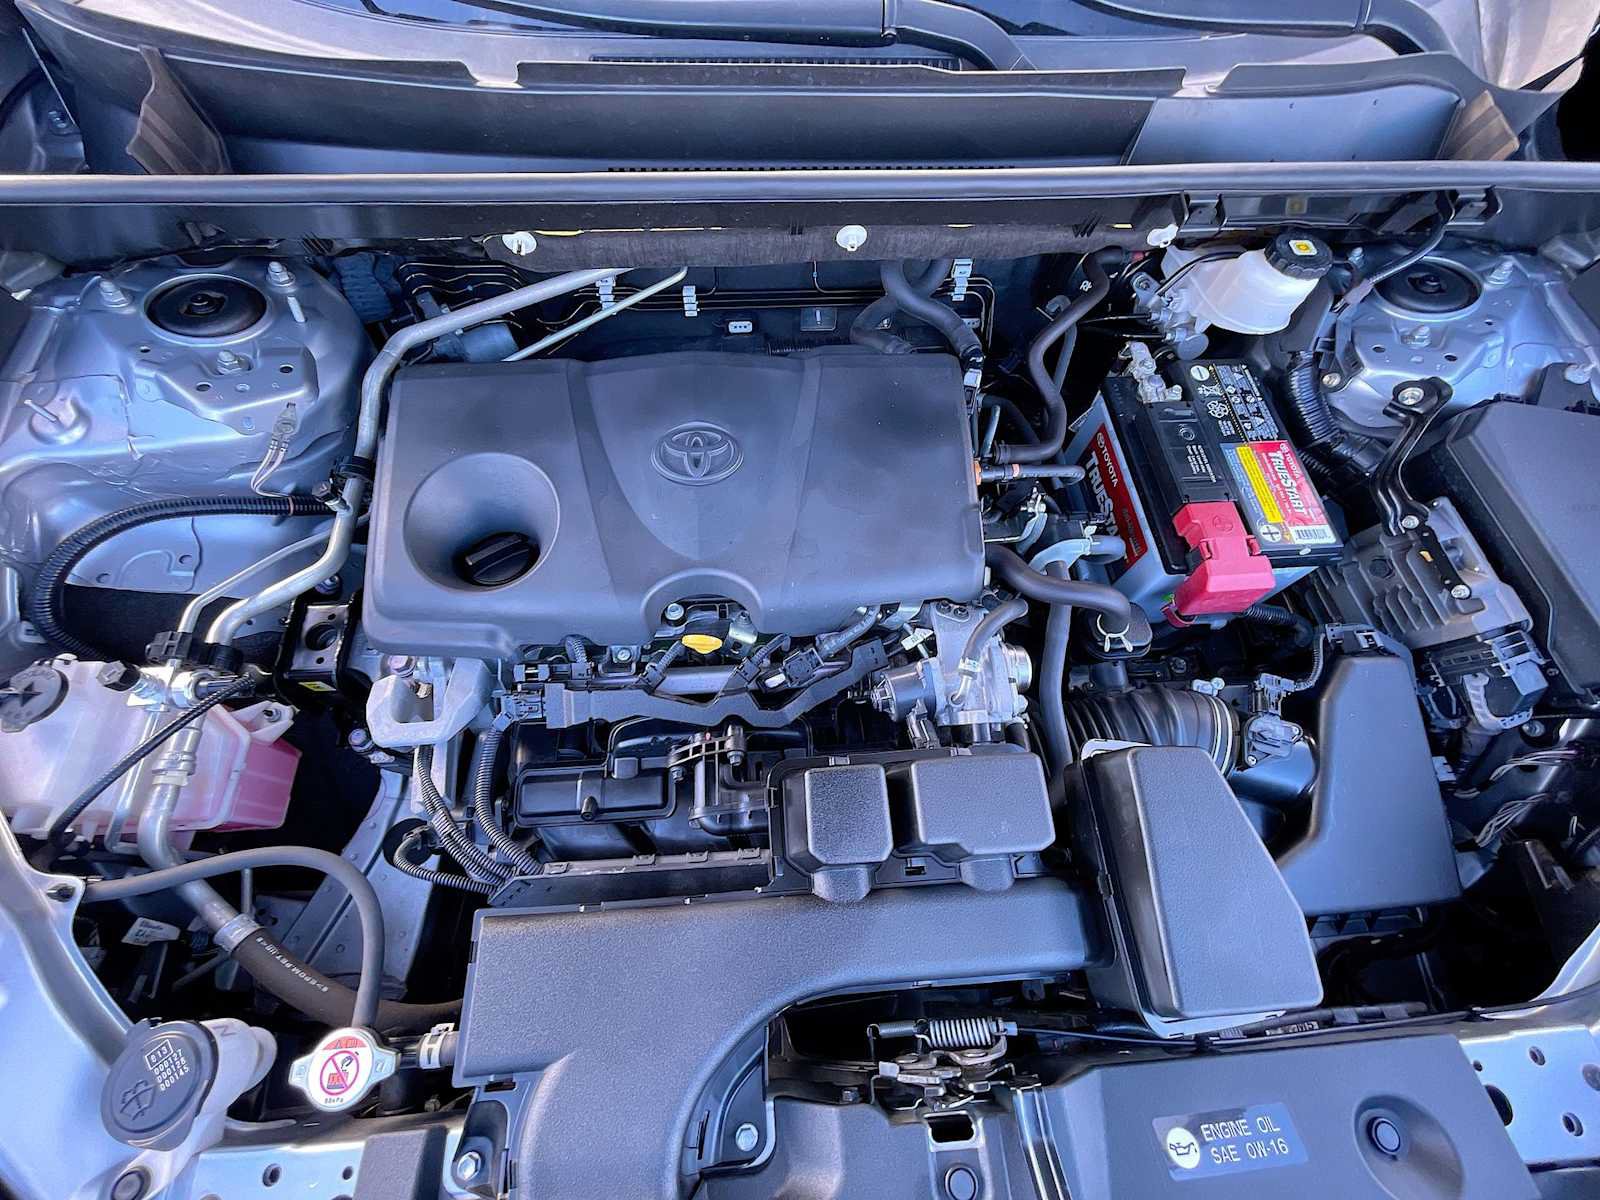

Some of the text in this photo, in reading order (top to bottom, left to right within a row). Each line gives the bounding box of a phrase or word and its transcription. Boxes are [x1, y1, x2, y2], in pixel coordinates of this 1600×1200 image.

[1102, 448, 1118, 487] TOYOTA
[1285, 452, 1301, 480] TOYOTA
[1200, 1116, 1281, 1142] ENGINE OIL
[1210, 1137, 1289, 1164] SAE 0W-16
